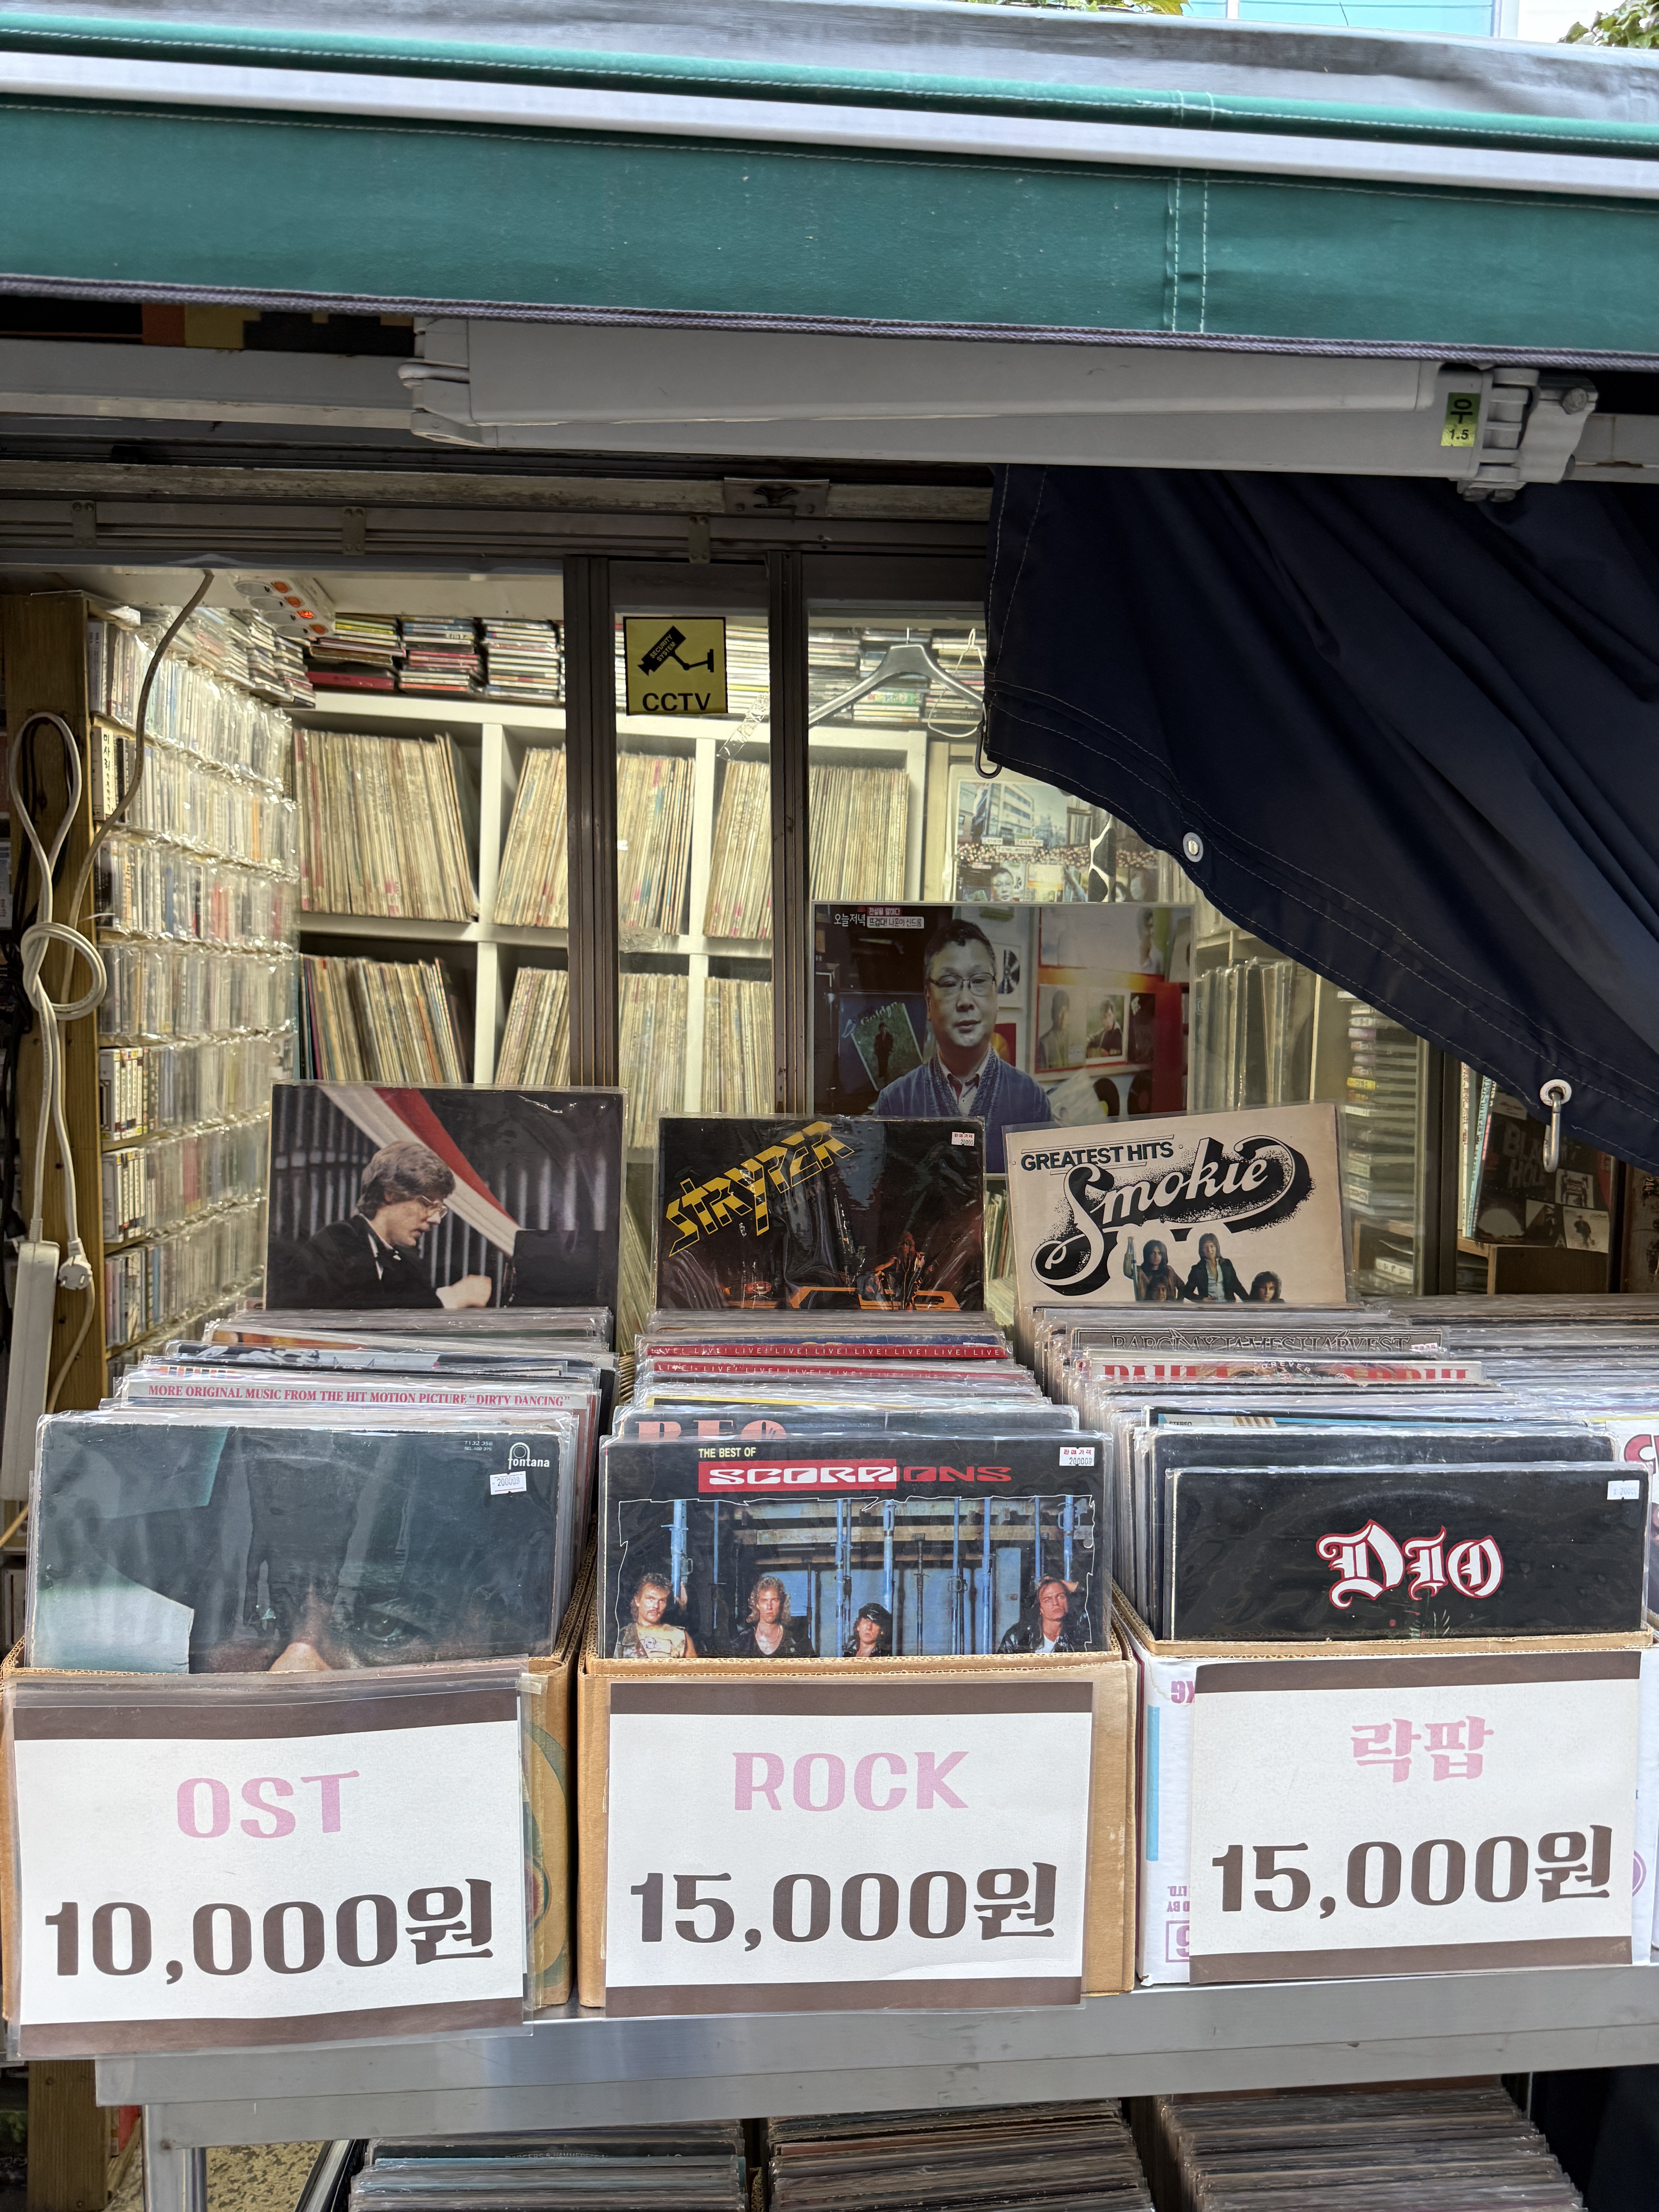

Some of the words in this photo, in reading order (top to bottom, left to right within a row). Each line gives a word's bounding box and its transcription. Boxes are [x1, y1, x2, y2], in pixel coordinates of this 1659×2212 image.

[1449, 429, 1469, 440] 1.5
[650, 634, 673, 658] SECURITY
[657, 642, 676, 661] SYSTEM
[642, 693, 711, 711] CCTV
[834, 914, 866, 927] 오늘저녁
[1020, 1144, 1123, 1172] GREATEST
[1128, 1141, 1174, 1164] HITS
[665, 1121, 855, 1258] STRYPER
[1030, 1134, 1314, 1296] Smokie
[148, 1385, 182, 1396] MORE
[185, 1386, 242, 1398] ORIGINAL
[245, 1388, 281, 1400] MUSIC
[285, 1389, 316, 1401] FROM
[320, 1391, 343, 1401] THE
[346, 1391, 368, 1402] HIT
[370, 1392, 416, 1403] MOTION
[419, 1393, 467, 1404] PICTURE
[698, 1448, 716, 1458] THE
[719, 1448, 741, 1458] BEST
[744, 1447, 756, 1457] OF
[709, 1466, 1012, 1485] SCORPIONS
[1350, 1715, 1494, 1783] 락팝
[733, 1751, 969, 1812] ROCK
[176, 1770, 360, 1839] OST
[1212, 1824, 1613, 1920] 15,000원
[630, 1862, 1058, 1952] 15,000원
[45, 1878, 494, 1985] 10,000원
